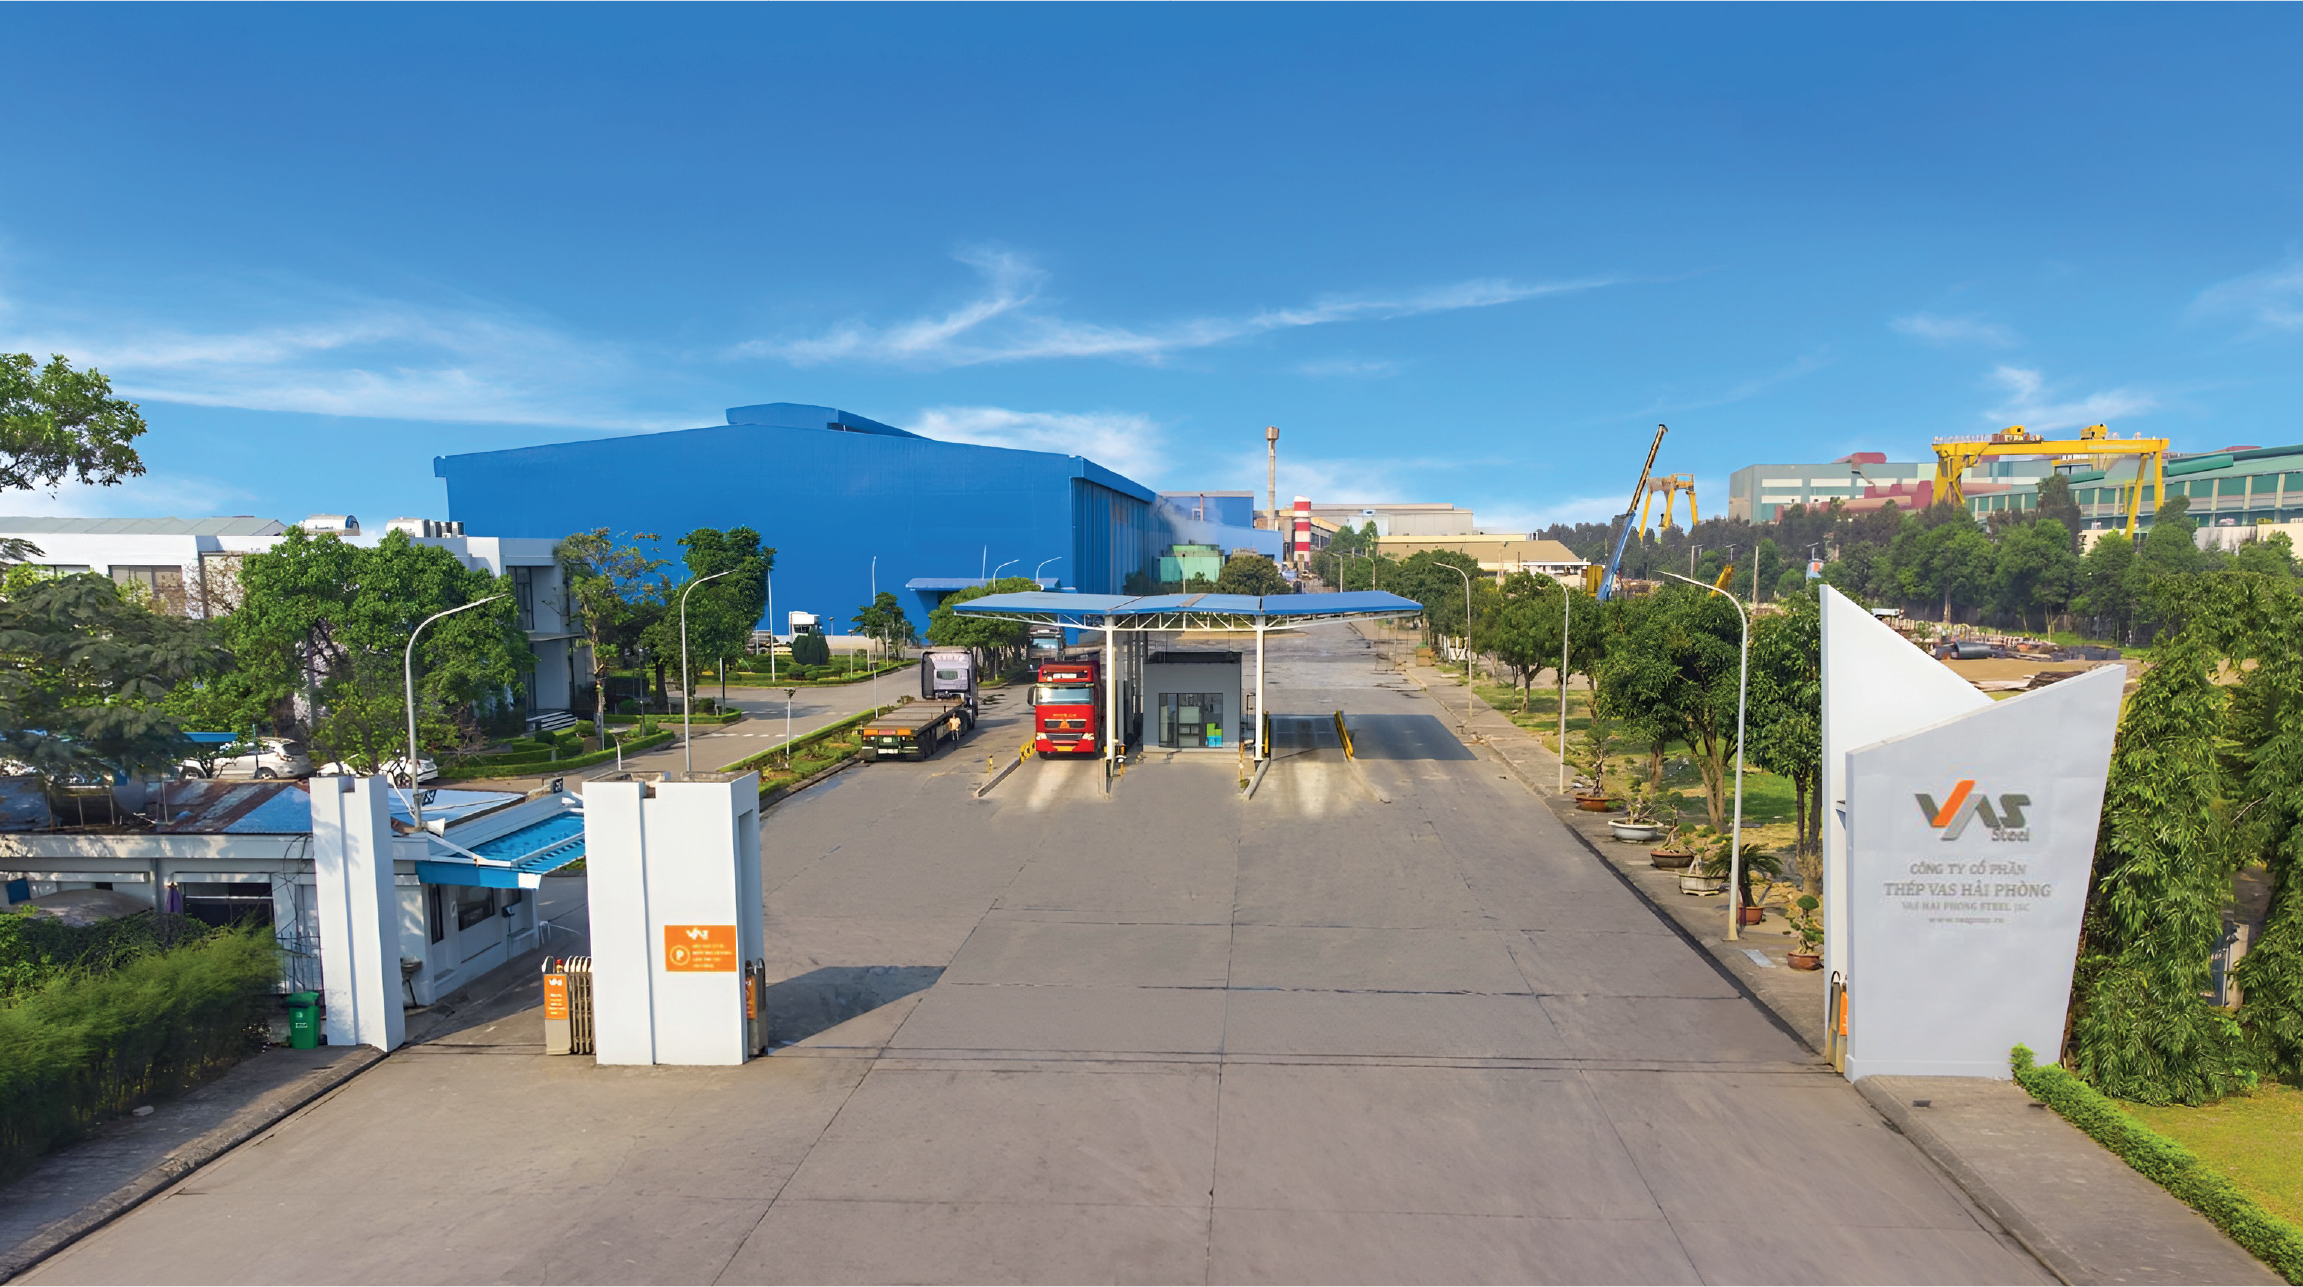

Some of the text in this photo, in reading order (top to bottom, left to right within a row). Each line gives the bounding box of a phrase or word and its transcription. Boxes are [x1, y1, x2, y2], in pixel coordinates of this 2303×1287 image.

[1914, 779, 2031, 841] VAS
[1991, 827, 2030, 842] Steel
[1909, 861, 1943, 875] CÔNG
[1947, 863, 1965, 875] TY
[1926, 882, 1957, 897] VAS
[1961, 879, 1989, 897] HẢI
[1994, 880, 2052, 898] PHÒNG
